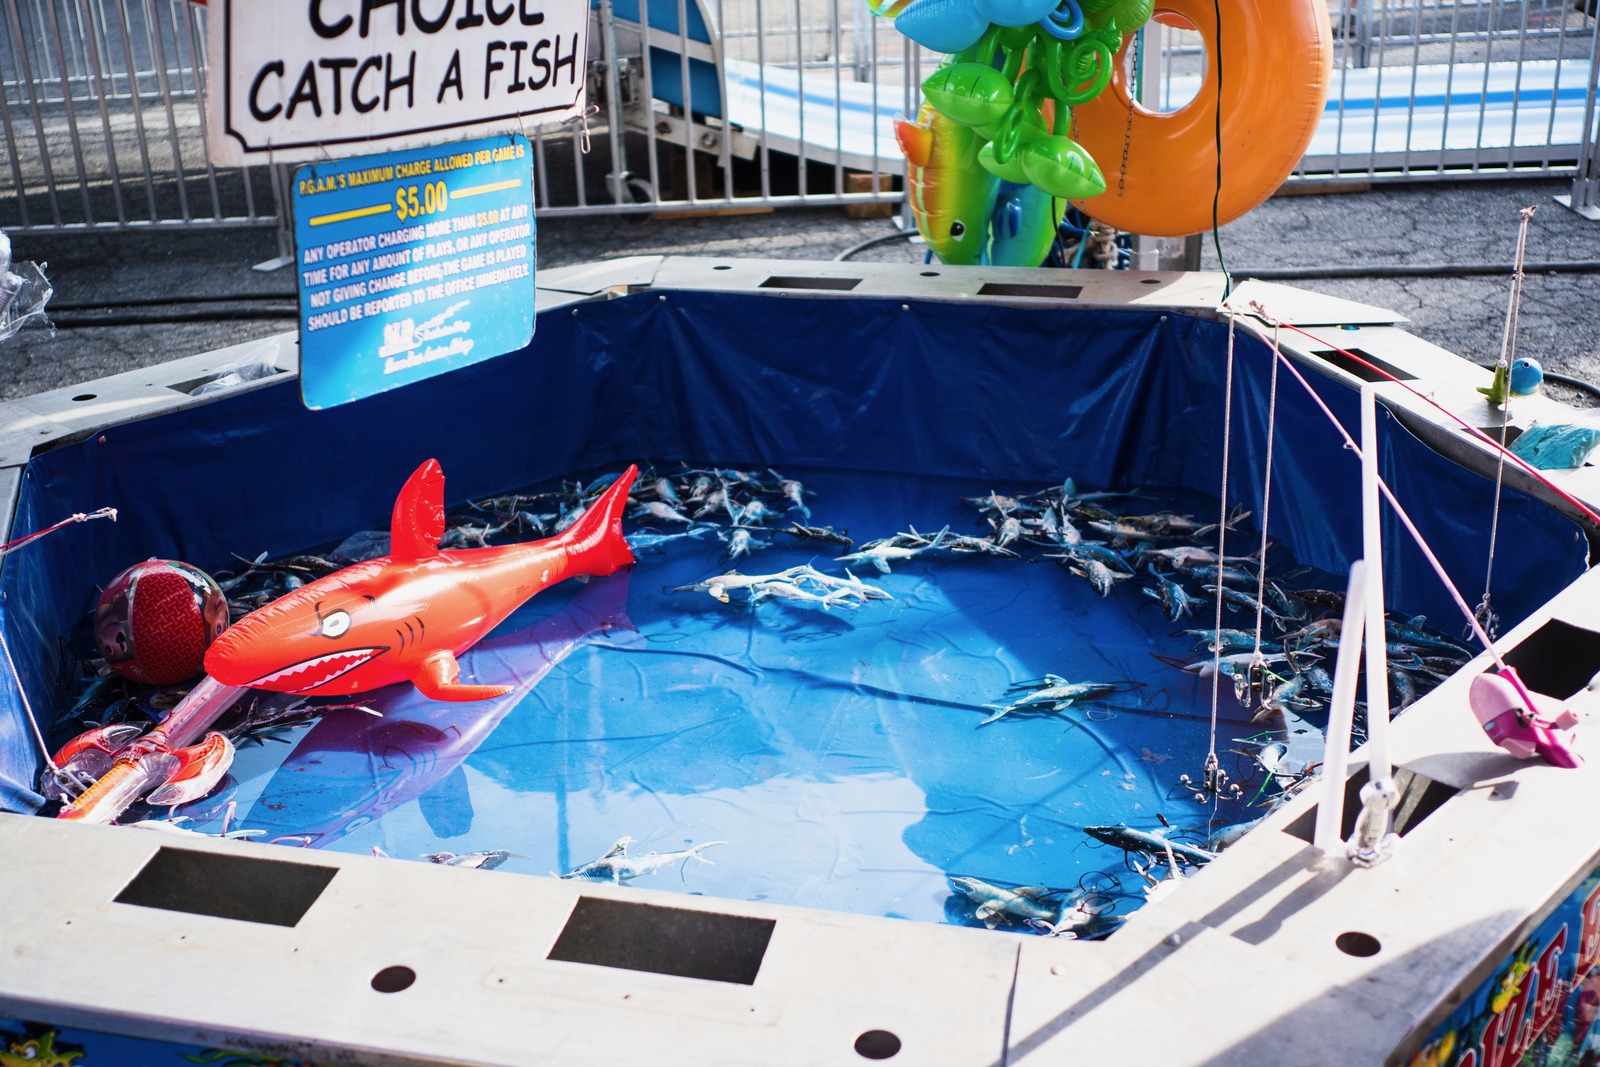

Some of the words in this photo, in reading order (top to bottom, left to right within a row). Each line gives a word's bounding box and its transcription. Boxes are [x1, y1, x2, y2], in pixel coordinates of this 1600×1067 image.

[249, 50, 416, 122] CATCH
[437, 48, 463, 104] A
[484, 32, 578, 101] FISH
[348, 166, 394, 186] MAXIMUM
[396, 160, 432, 178] CHARGE
[434, 153, 473, 171] ALLOWED
[475, 150, 490, 164] PER
[493, 146, 514, 162] GAME
[516, 145, 524, 158] IS
[396, 180, 448, 221] $5.00
[303, 268, 327, 286] TIME
[329, 263, 348, 280] FOR
[350, 258, 370, 276] ANY
[372, 250, 411, 271] AMOUNT
[412, 247, 425, 262] OF
[457, 237, 469, 251] OR
[470, 233, 487, 248] ANY
[489, 223, 531, 244] OPERATOR
[304, 246, 324, 263] ANY
[327, 236, 376, 258] OPERATOR
[378, 226, 424, 248] CHARGING
[426, 220, 451, 237] MORE
[453, 215, 476, 232] THAN
[478, 211, 498, 227] $5.00
[500, 208, 510, 222] AT
[512, 205, 528, 219] ANY
[308, 309, 348, 331] SHOULD
[350, 305, 363, 320] BE
[365, 293, 412, 317] REPORTED
[414, 290, 425, 304] TO
[426, 285, 444, 301] THE
[445, 277, 475, 296] OFFICE
[476, 264, 529, 288] IMMEDIATELY.
[311, 290, 331, 309] NOT
[333, 282, 366, 303] GIVING
[368, 273, 406, 295] CHANGE
[443, 260, 460, 276] THE
[462, 254, 485, 272] GAME
[487, 252, 495, 266] IS
[497, 244, 526, 263] PLAYED
